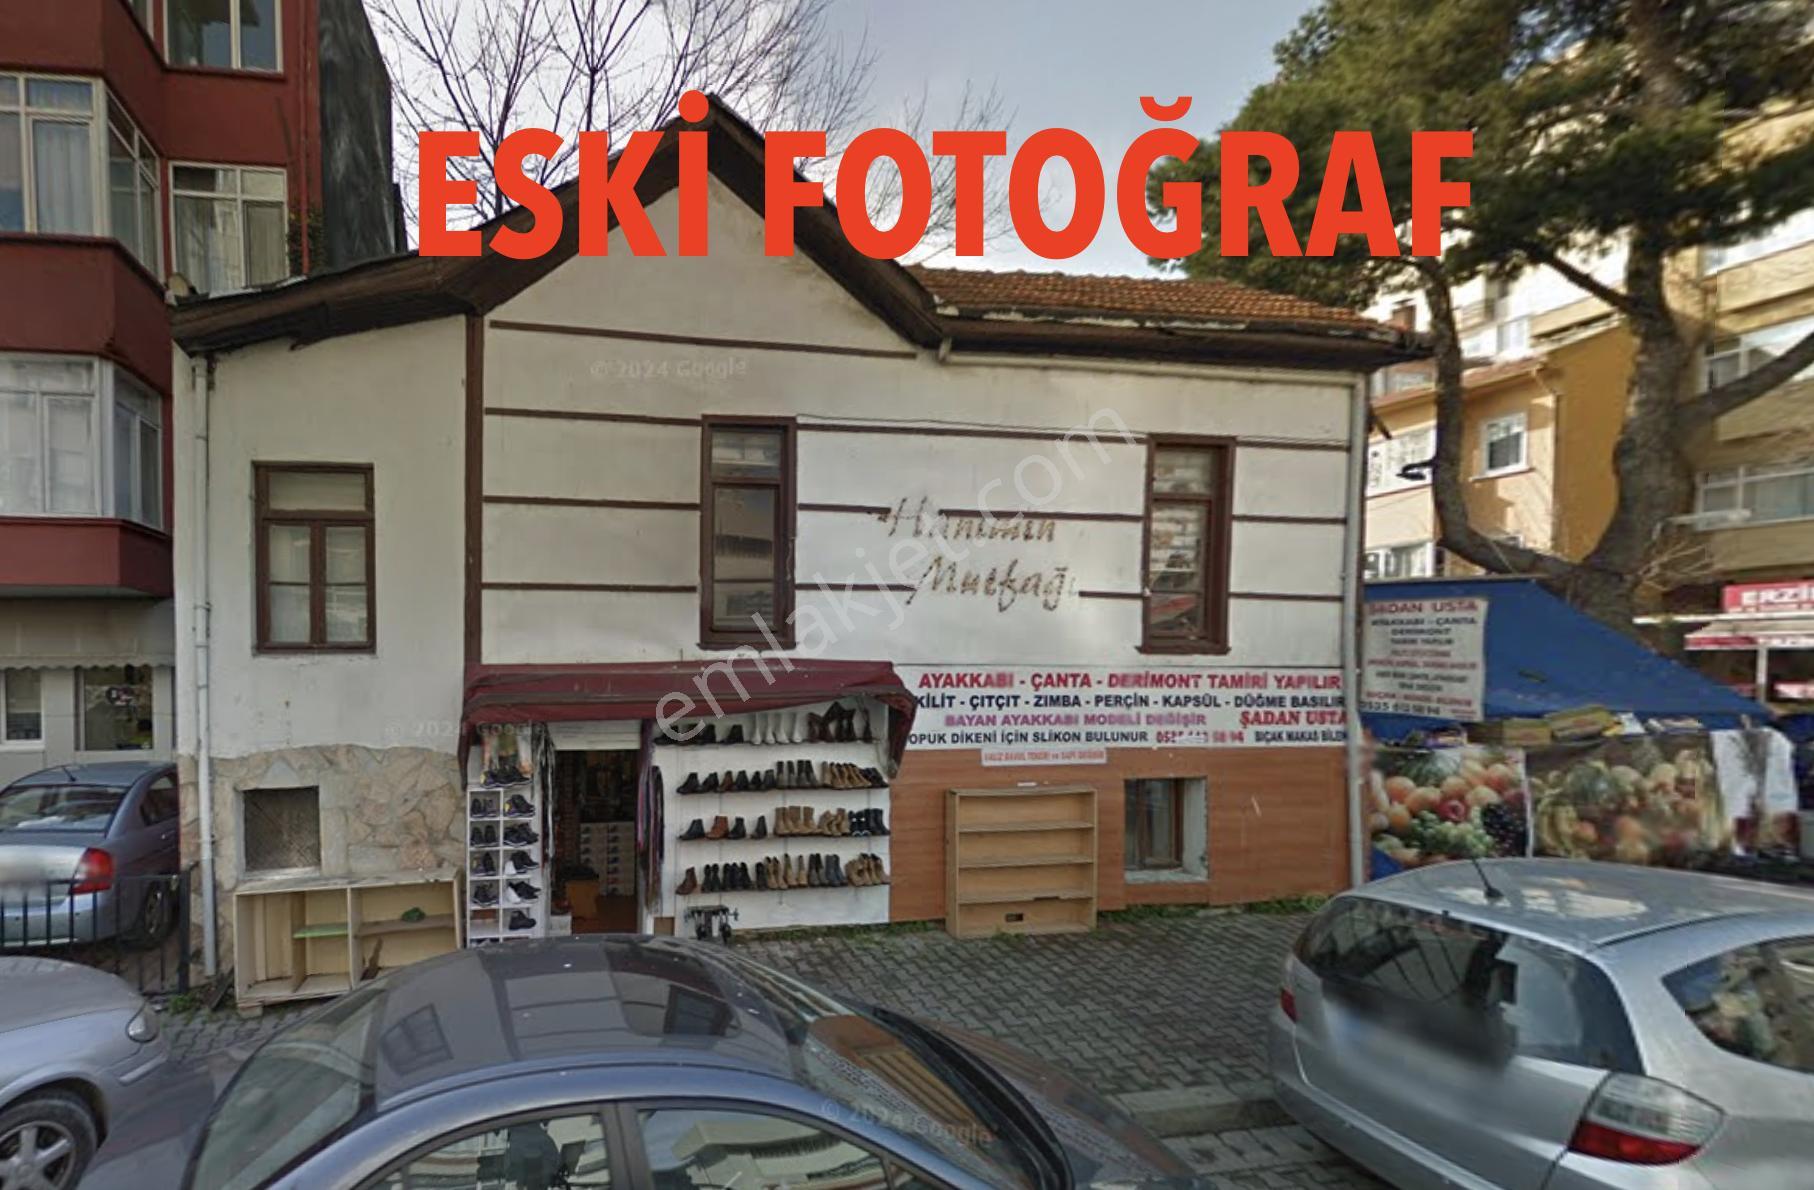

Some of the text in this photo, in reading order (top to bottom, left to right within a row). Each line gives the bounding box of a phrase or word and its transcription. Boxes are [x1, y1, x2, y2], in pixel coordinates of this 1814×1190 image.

[918, 671, 1341, 692] AYAKKABI ÇANTA DERİMONT TAMİRİ YAPILIR
[970, 695, 1020, 711] ÇITÇIT
[1033, 695, 1081, 708] ZIMBA
[1094, 693, 1149, 711] PERÇİN
[1162, 692, 1221, 708] KAPSÜL
[1234, 692, 1286, 708] DÜĞME
[945, 714, 997, 727] BAYAN
[1001, 714, 1078, 727] AYAKKABI
[1084, 711, 1140, 726] MODELİ
[1240, 711, 1347, 729] ŞADAN USTA
[951, 731, 997, 744] DİKENİ
[1001, 730, 1028, 745] İÇİN
[1032, 730, 1081, 743] SLİKON
[1086, 731, 1148, 743] BULUNUR
